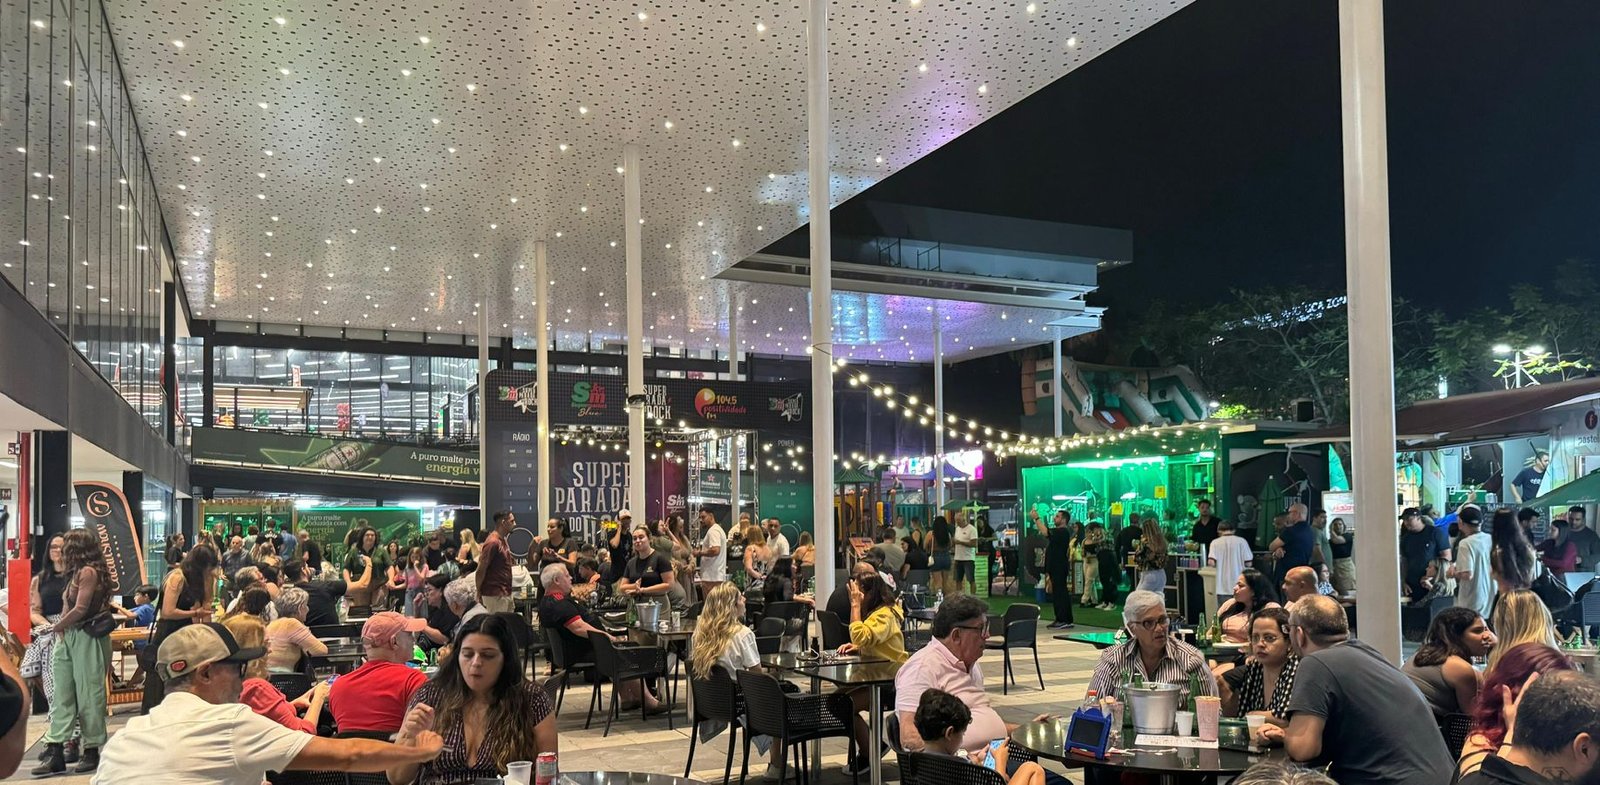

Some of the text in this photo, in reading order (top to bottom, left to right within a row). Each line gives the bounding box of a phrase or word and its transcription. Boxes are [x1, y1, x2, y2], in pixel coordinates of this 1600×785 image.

[643, 384, 667, 396] SUPER
[512, 431, 531, 441] RÁDIO
[410, 451, 481, 466] A puro malte pro
[425, 462, 471, 476] energia
[572, 461, 631, 487] SUPER
[554, 487, 632, 513] PARADA
